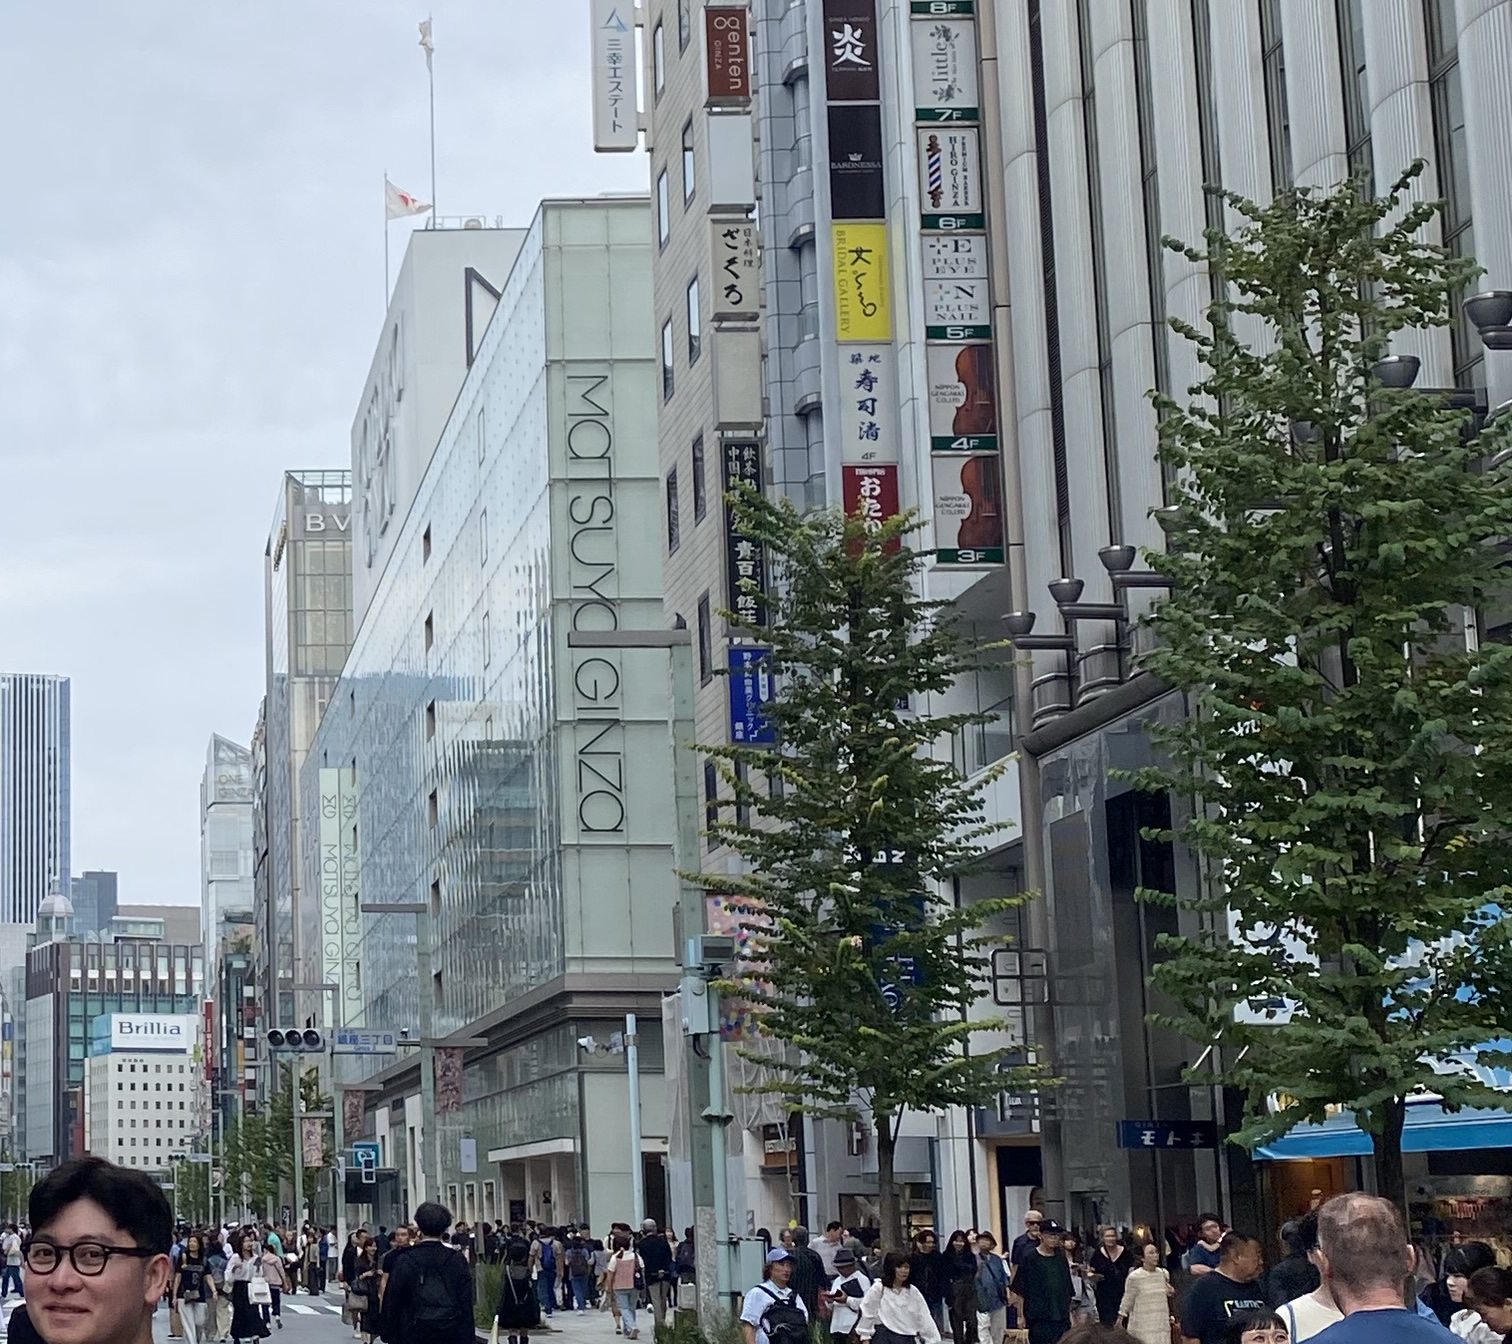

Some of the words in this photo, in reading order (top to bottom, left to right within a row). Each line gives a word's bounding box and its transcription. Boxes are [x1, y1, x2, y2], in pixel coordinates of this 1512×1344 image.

[930, 2, 957, 14] 8F
[832, 23, 871, 66] 炎
[714, 17, 742, 90] genten
[714, 40, 722, 70] GINZA
[931, 41, 949, 83] little
[607, 39, 623, 132] 三幸エステート
[934, 109, 962, 121] 7F
[831, 161, 881, 169] BARONESSA
[950, 168, 960, 206] GINZA
[939, 217, 966, 229] 6F
[836, 229, 847, 274] BRIDAL
[721, 228, 743, 305] ざくろ
[932, 257, 977, 265] PLUS
[935, 266, 975, 274] EYE
[838, 278, 850, 334] GALLERY
[934, 304, 979, 312] PLUS
[936, 312, 978, 321] NAIL
[946, 326, 974, 339] 5F
[855, 369, 881, 441] 寿司清
[951, 437, 980, 449] 4F
[957, 550, 986, 562] 3F
[218, 774, 243, 785] ONE
[118, 1021, 181, 1035] Brillia
[338, 1034, 393, 1045] 銀座三丁目
